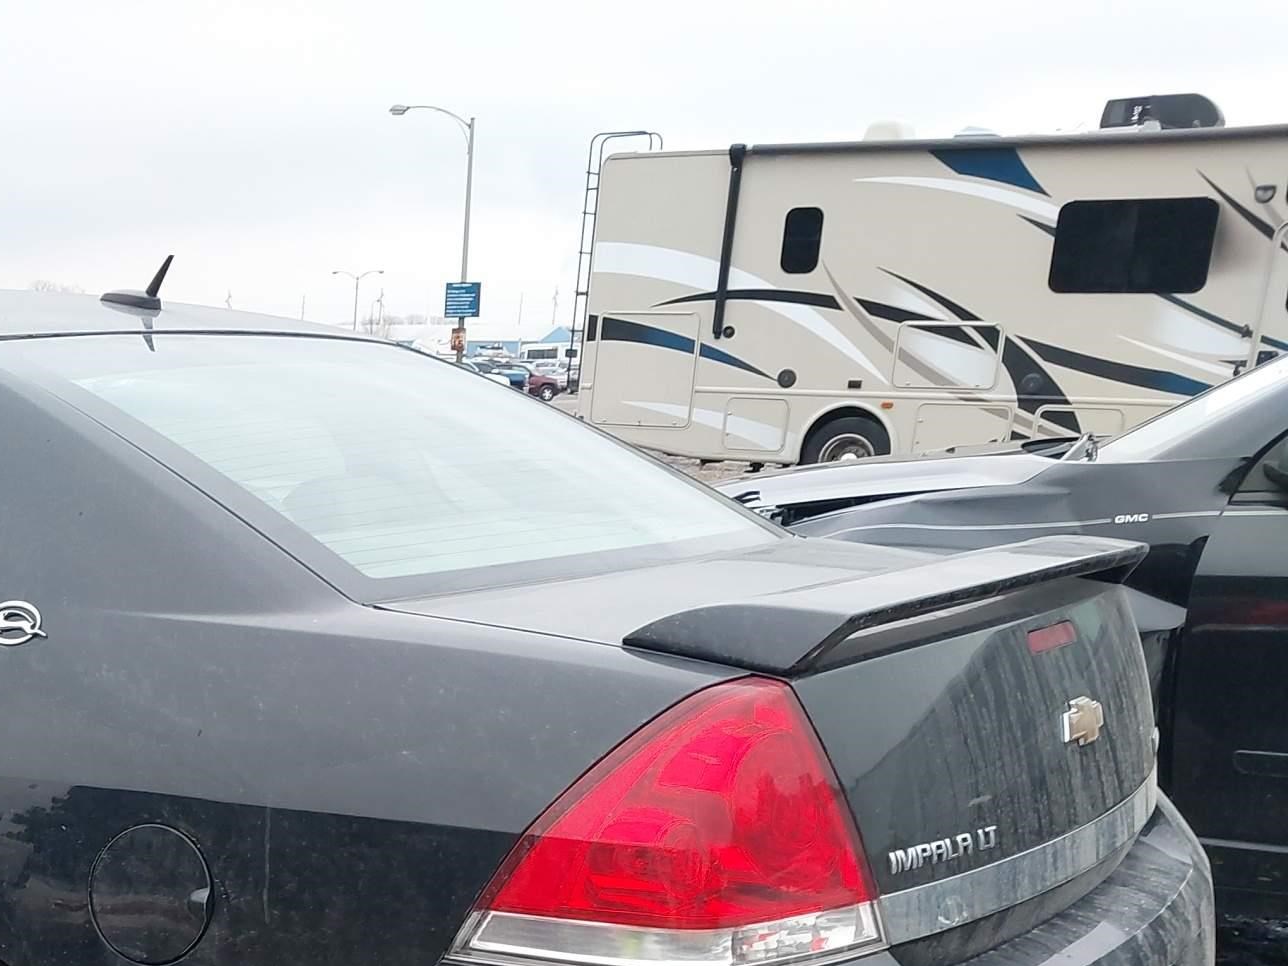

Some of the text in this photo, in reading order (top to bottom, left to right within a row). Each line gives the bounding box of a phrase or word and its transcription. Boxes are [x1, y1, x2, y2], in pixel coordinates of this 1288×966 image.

[1114, 513, 1149, 524] GMC
[889, 826, 998, 874] IMPALA LT
